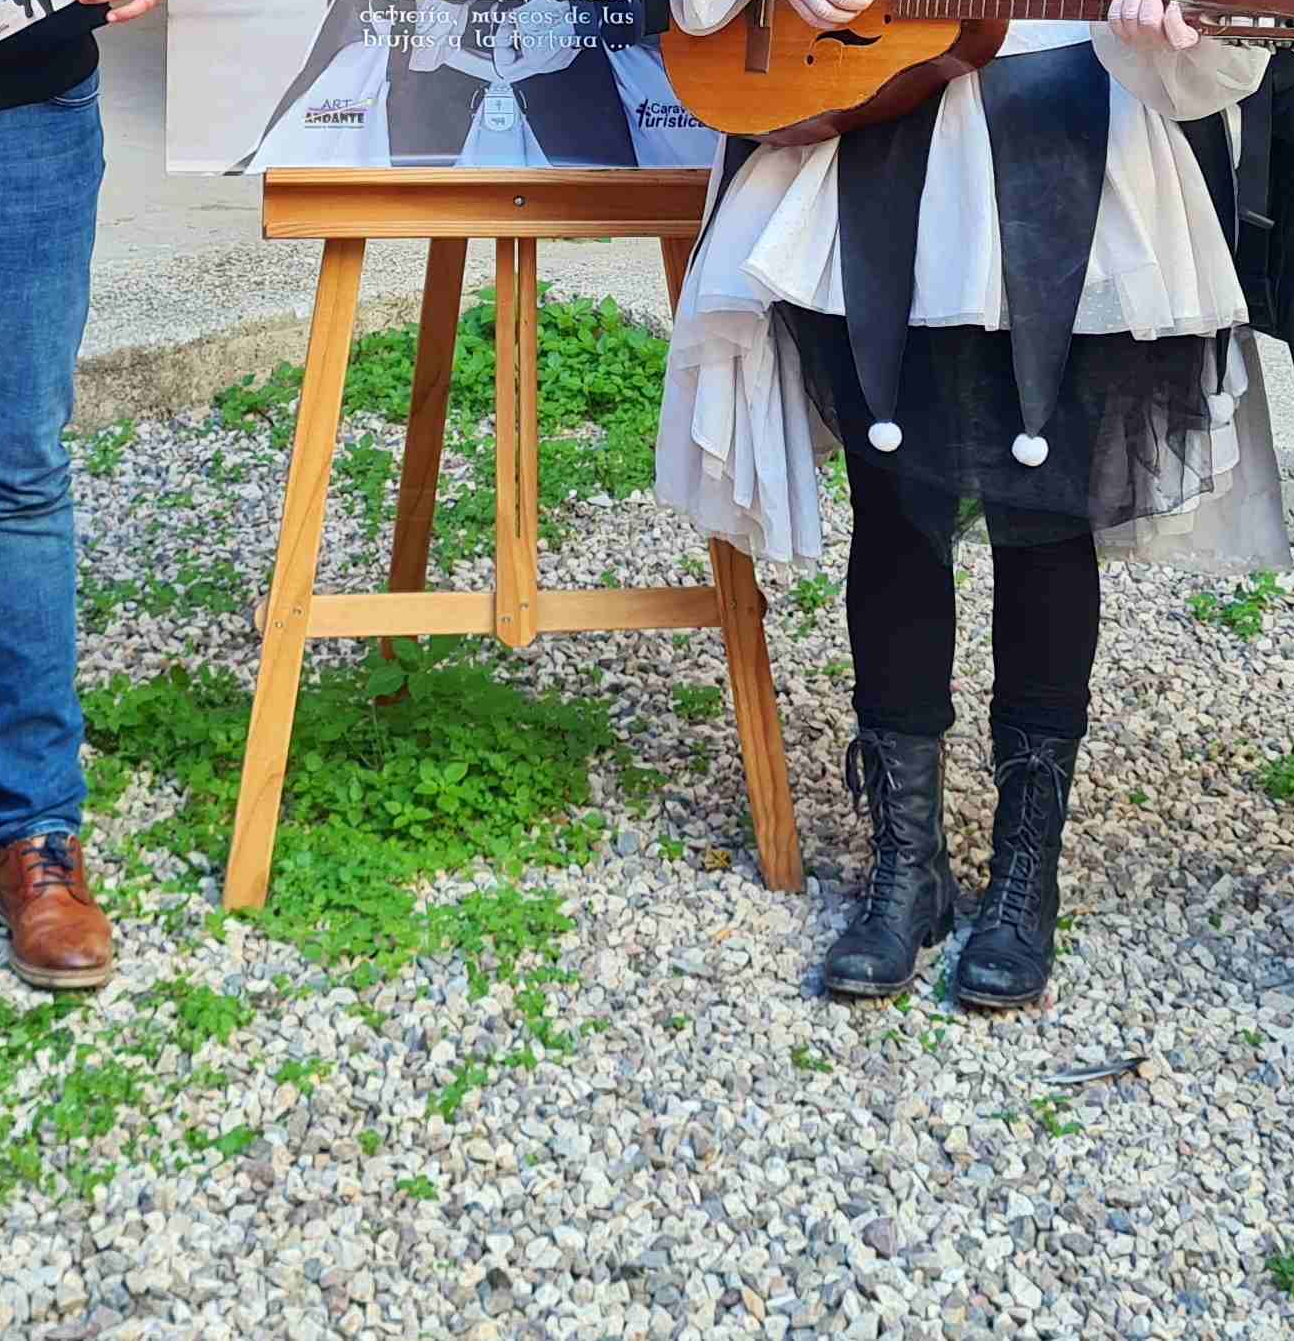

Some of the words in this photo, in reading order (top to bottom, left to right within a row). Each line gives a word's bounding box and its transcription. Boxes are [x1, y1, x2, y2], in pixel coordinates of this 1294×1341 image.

[471, 11, 553, 25] museos
[564, 5, 591, 25] de
[602, 5, 634, 25] las
[361, 28, 435, 53] brujas
[448, 34, 461, 52] y
[474, 29, 496, 48] la
[510, 28, 598, 51] tortura
[321, 99, 354, 109] ART
[650, 102, 686, 115] Carav
[305, 111, 365, 124] ANDANTE
